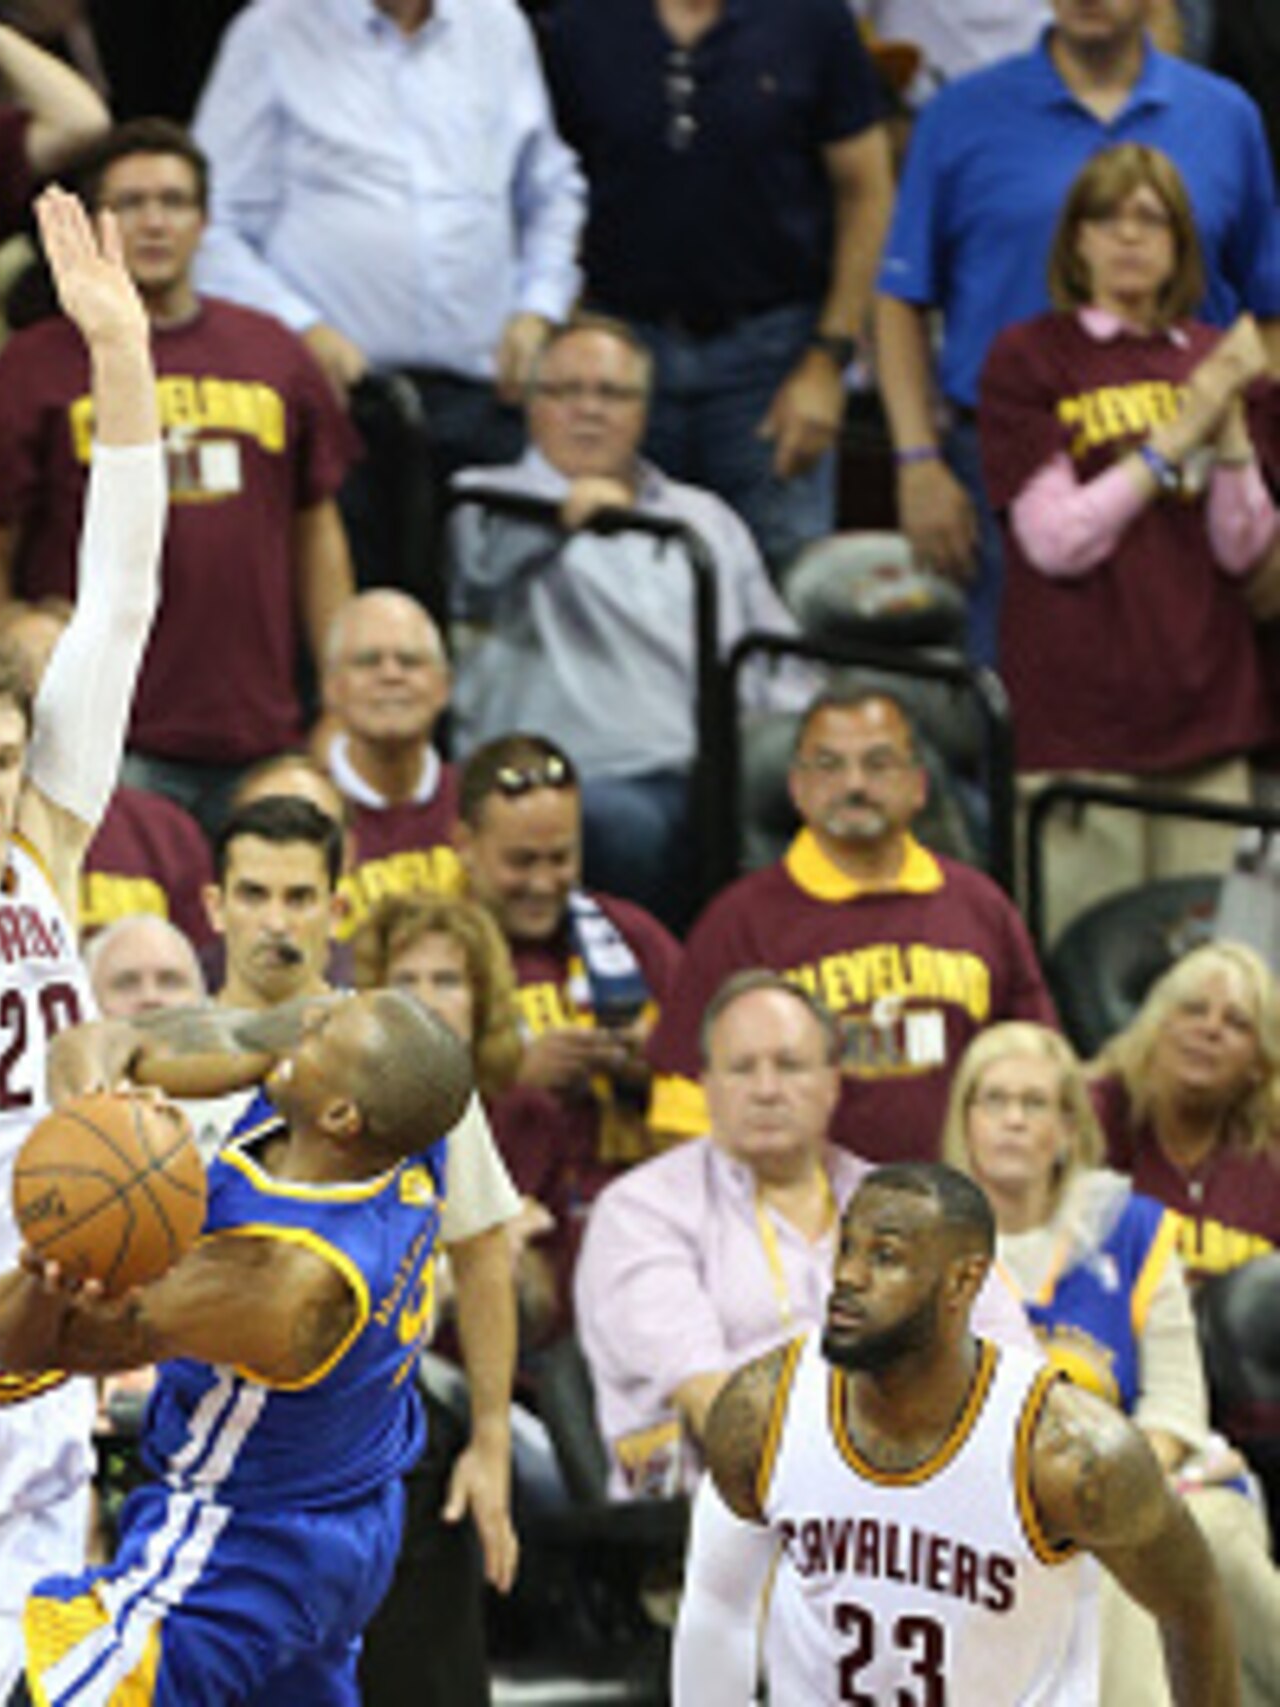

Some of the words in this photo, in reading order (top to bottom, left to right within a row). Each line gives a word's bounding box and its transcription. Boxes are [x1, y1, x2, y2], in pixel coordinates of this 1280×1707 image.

[786, 943, 991, 1021] LEVELAND
[778, 1517, 1016, 1613] CAVALIERS
[833, 1602, 946, 1707] 23
